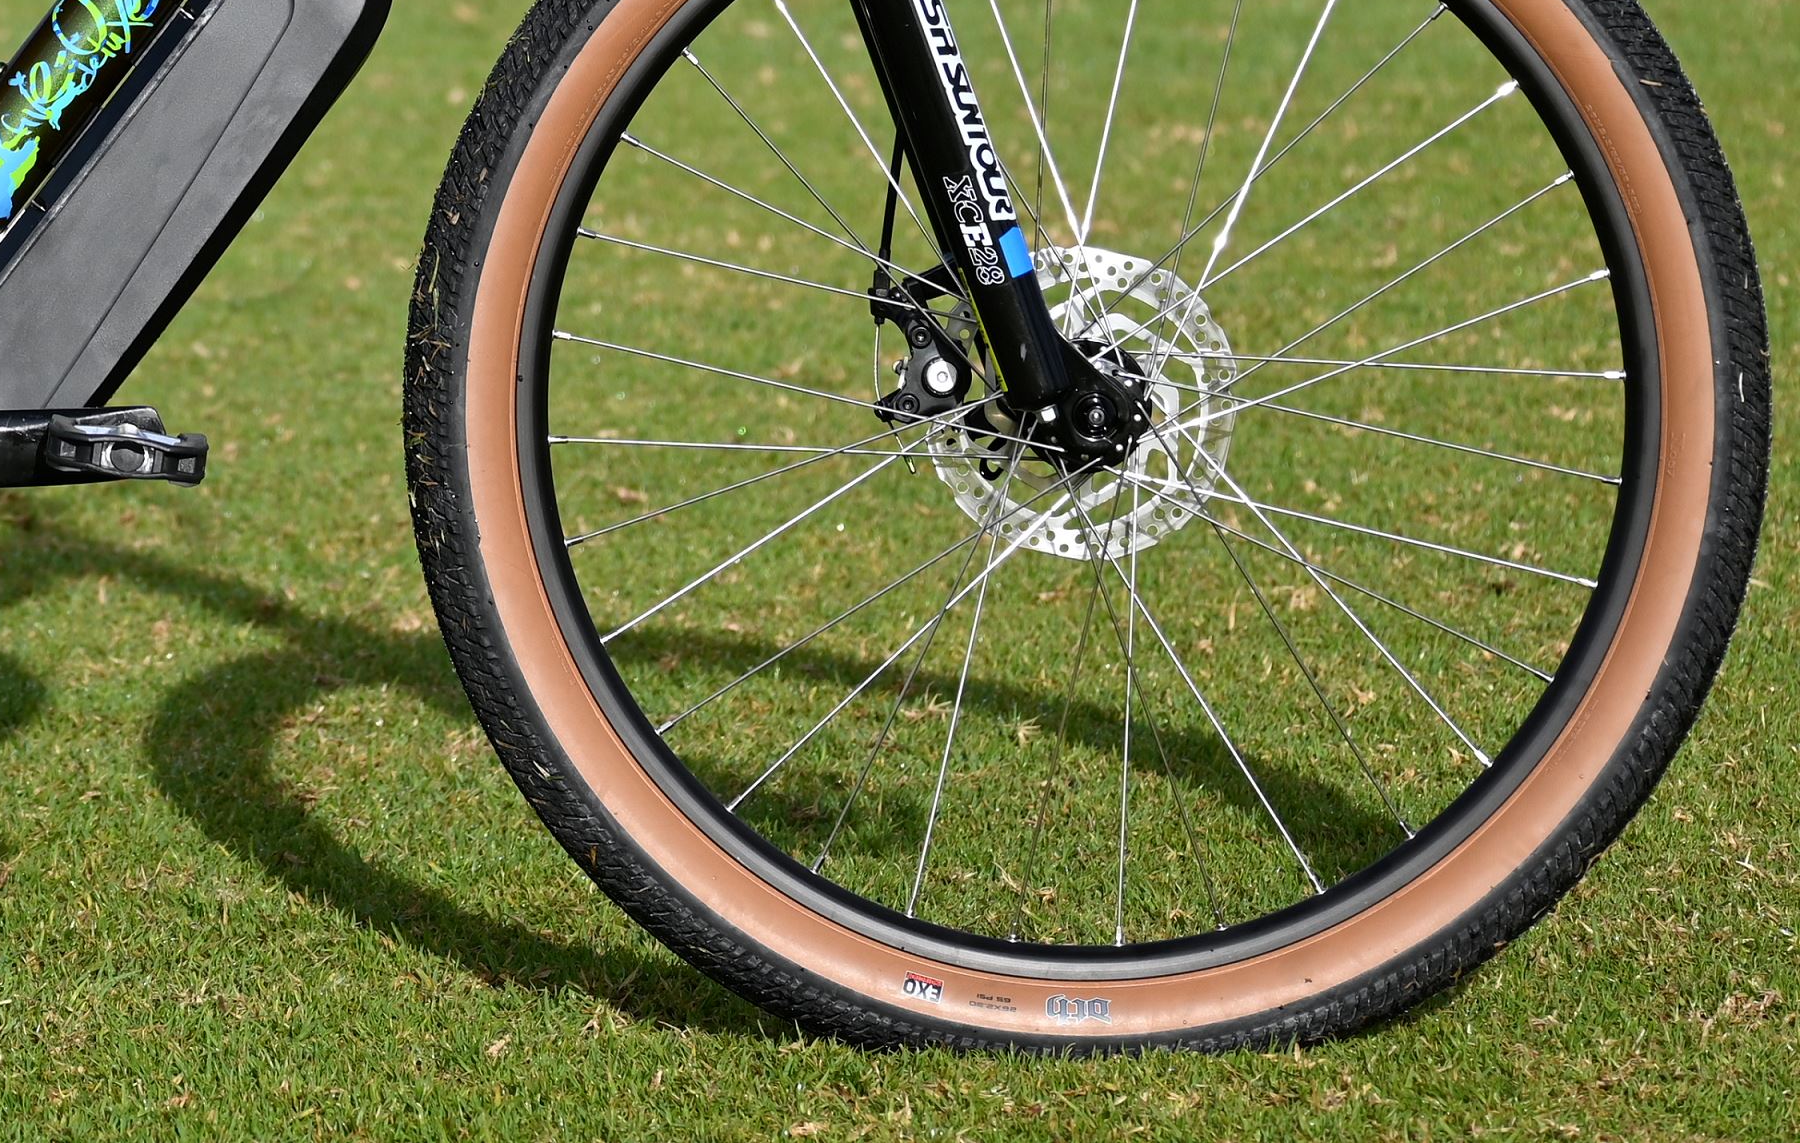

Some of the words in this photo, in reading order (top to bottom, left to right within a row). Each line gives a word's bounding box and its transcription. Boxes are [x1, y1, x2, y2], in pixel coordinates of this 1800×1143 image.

[943, 60, 1015, 219] SUNTOUR
[943, 174, 1005, 286] XCE28
[902, 977, 942, 1002] EXO
